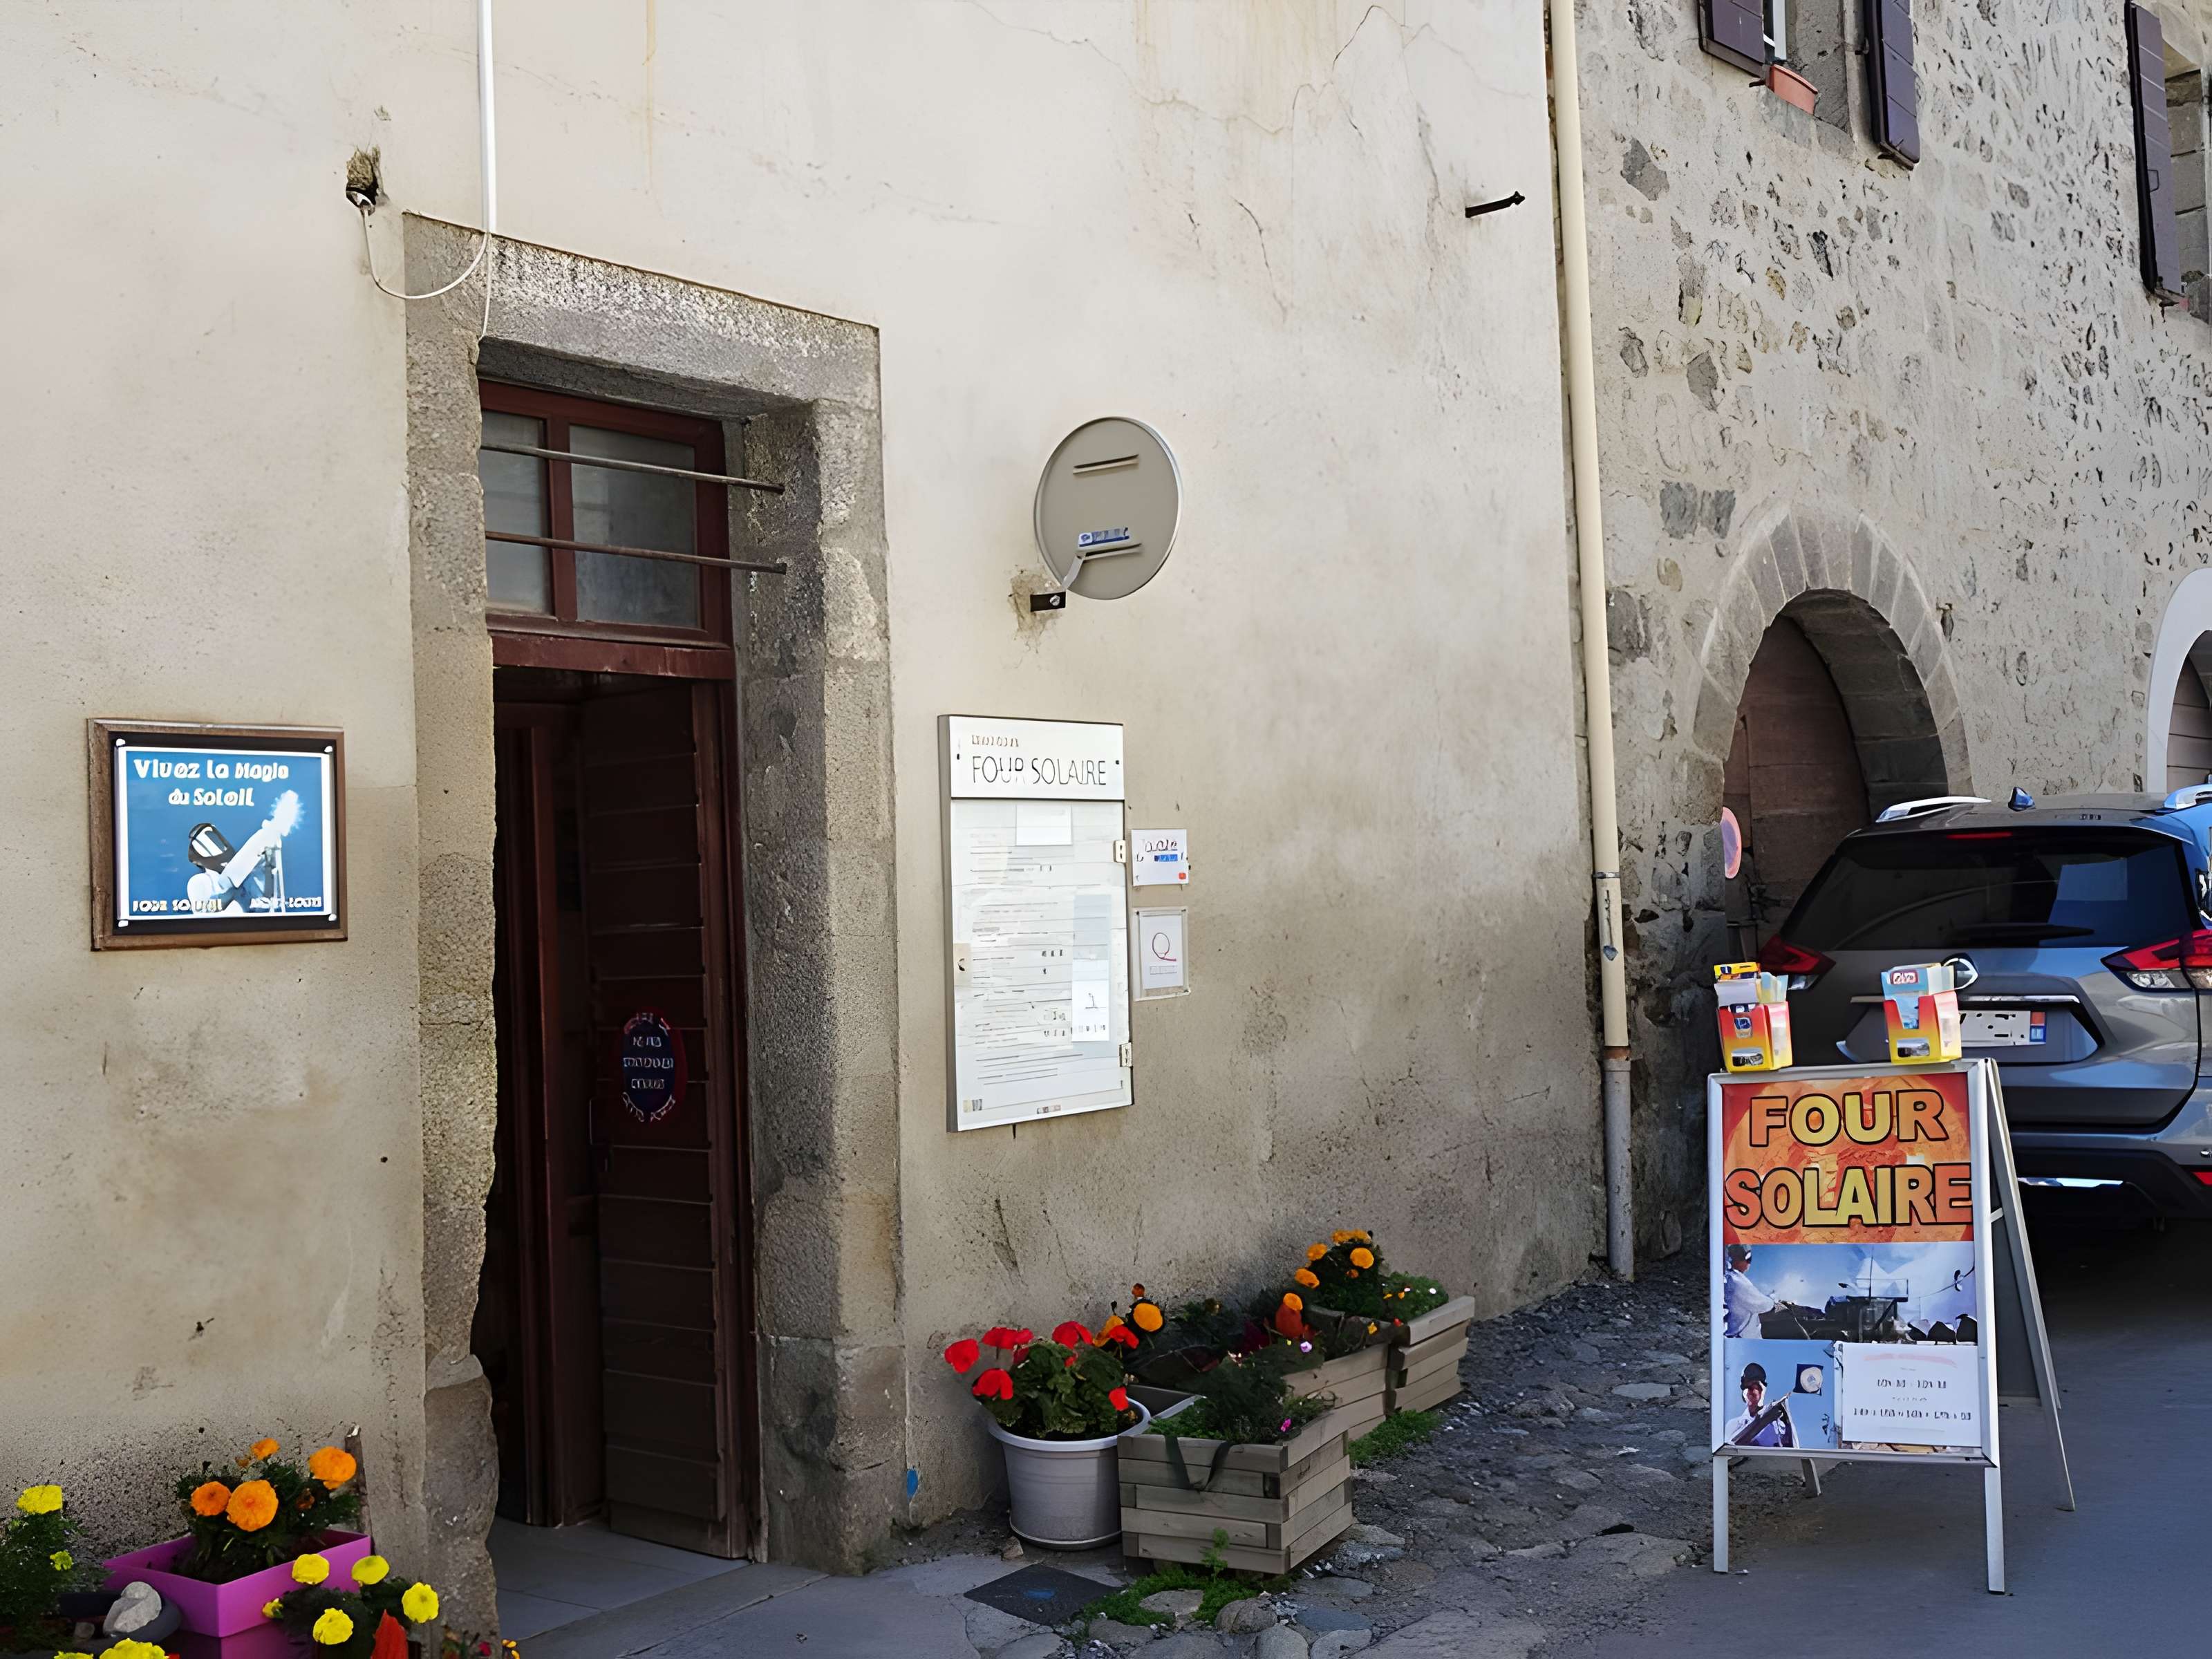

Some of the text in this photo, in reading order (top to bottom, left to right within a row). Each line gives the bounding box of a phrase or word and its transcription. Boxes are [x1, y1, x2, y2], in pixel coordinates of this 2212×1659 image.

[973, 756, 1106, 785] FOUR SOLAIRE
[1750, 1089, 1949, 1147] FOUR
[1725, 1163, 1973, 1229] SOLAIRE
